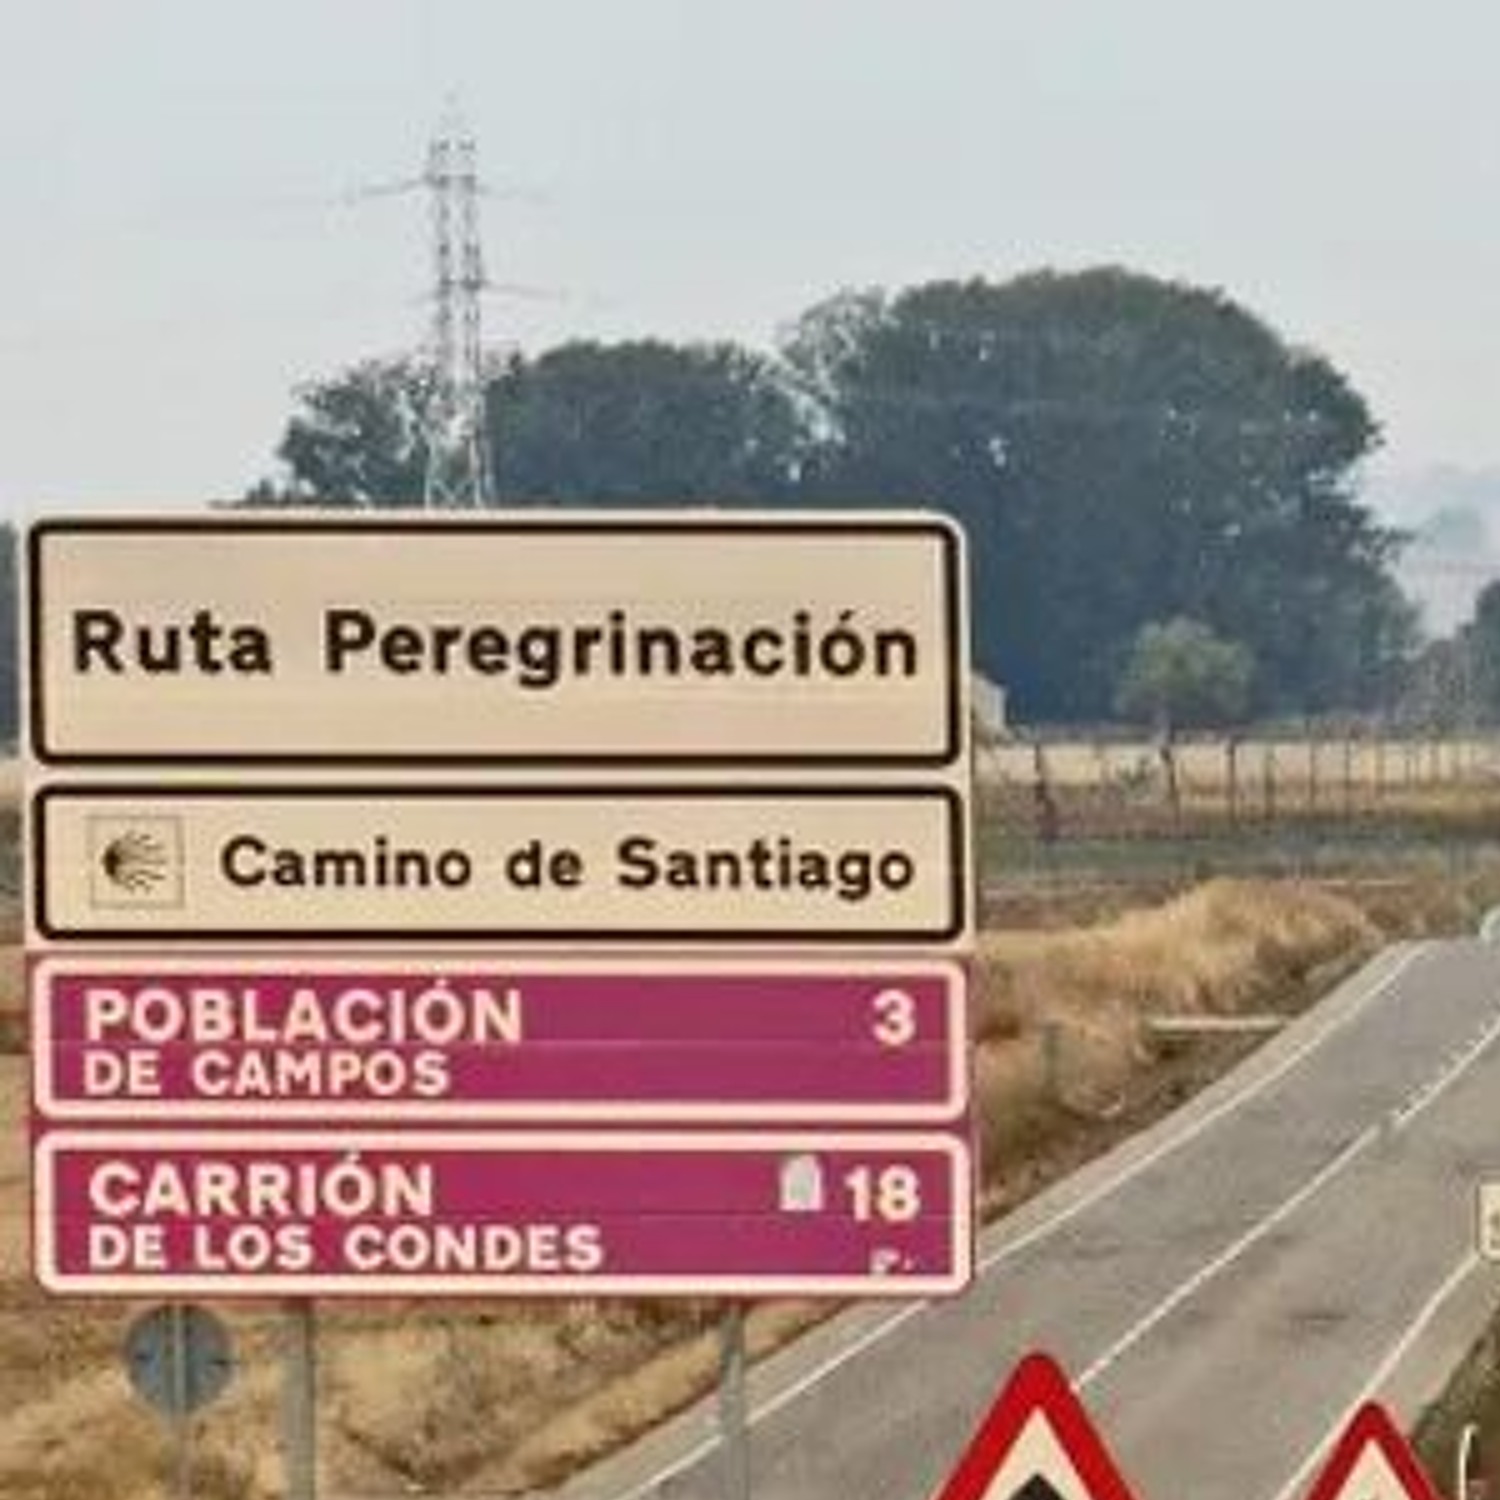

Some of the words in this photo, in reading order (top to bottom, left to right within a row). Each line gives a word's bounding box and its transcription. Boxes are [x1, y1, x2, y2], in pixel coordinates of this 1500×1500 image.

[73, 610, 272, 674] Ruta
[326, 609, 917, 689] Peregrinación
[221, 835, 472, 888] Camino
[506, 840, 582, 888] de
[618, 836, 914, 902] Santiago
[86, 979, 521, 1044] POBLACIÓN
[874, 989, 915, 1046] 3
[85, 1050, 161, 1095] DE
[193, 1049, 449, 1096] CAMPOS
[89, 1153, 432, 1217] CARRIÓN
[846, 1166, 920, 1221] 18
[89, 1224, 167, 1270] DE
[195, 1224, 313, 1271] LOS
[344, 1224, 603, 1271] CONDES
